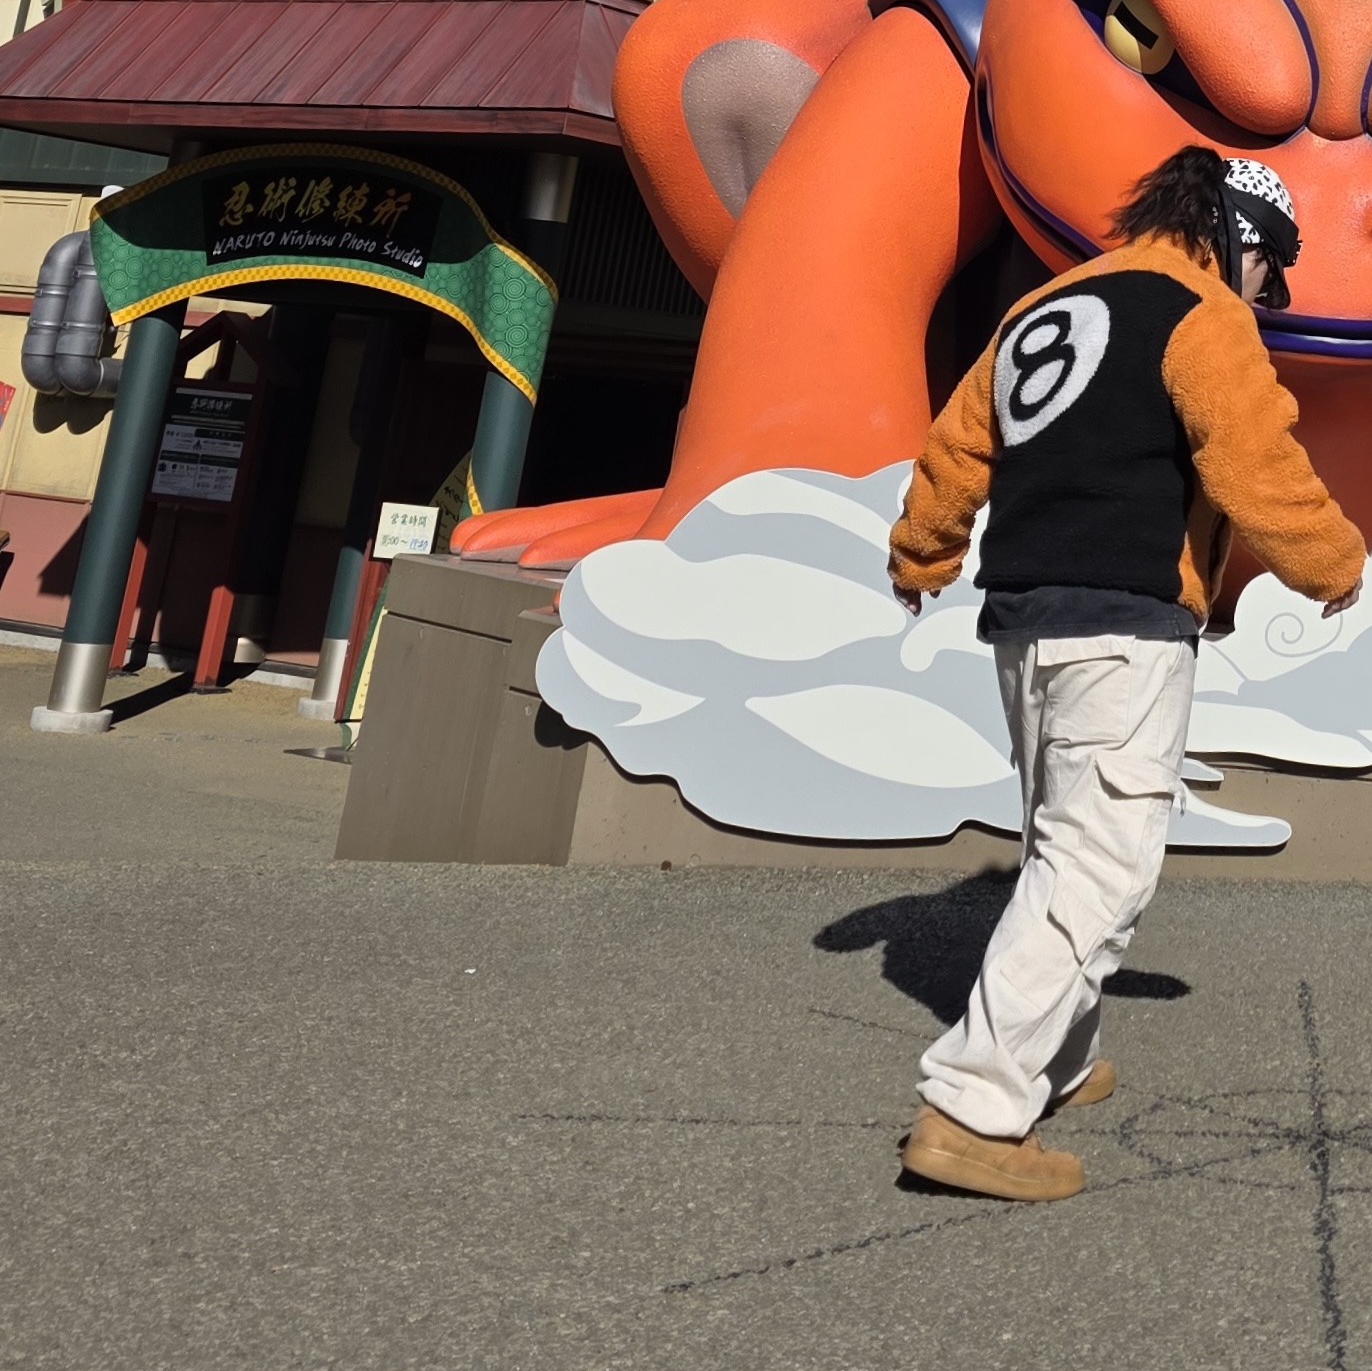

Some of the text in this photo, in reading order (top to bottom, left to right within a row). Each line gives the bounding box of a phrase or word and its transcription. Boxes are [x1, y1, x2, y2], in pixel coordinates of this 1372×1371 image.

[218, 176, 412, 239] 忍術修練所
[212, 229, 424, 268] NARUTO Ninjutsu Photo Studio
[1009, 310, 1077, 422] 8
